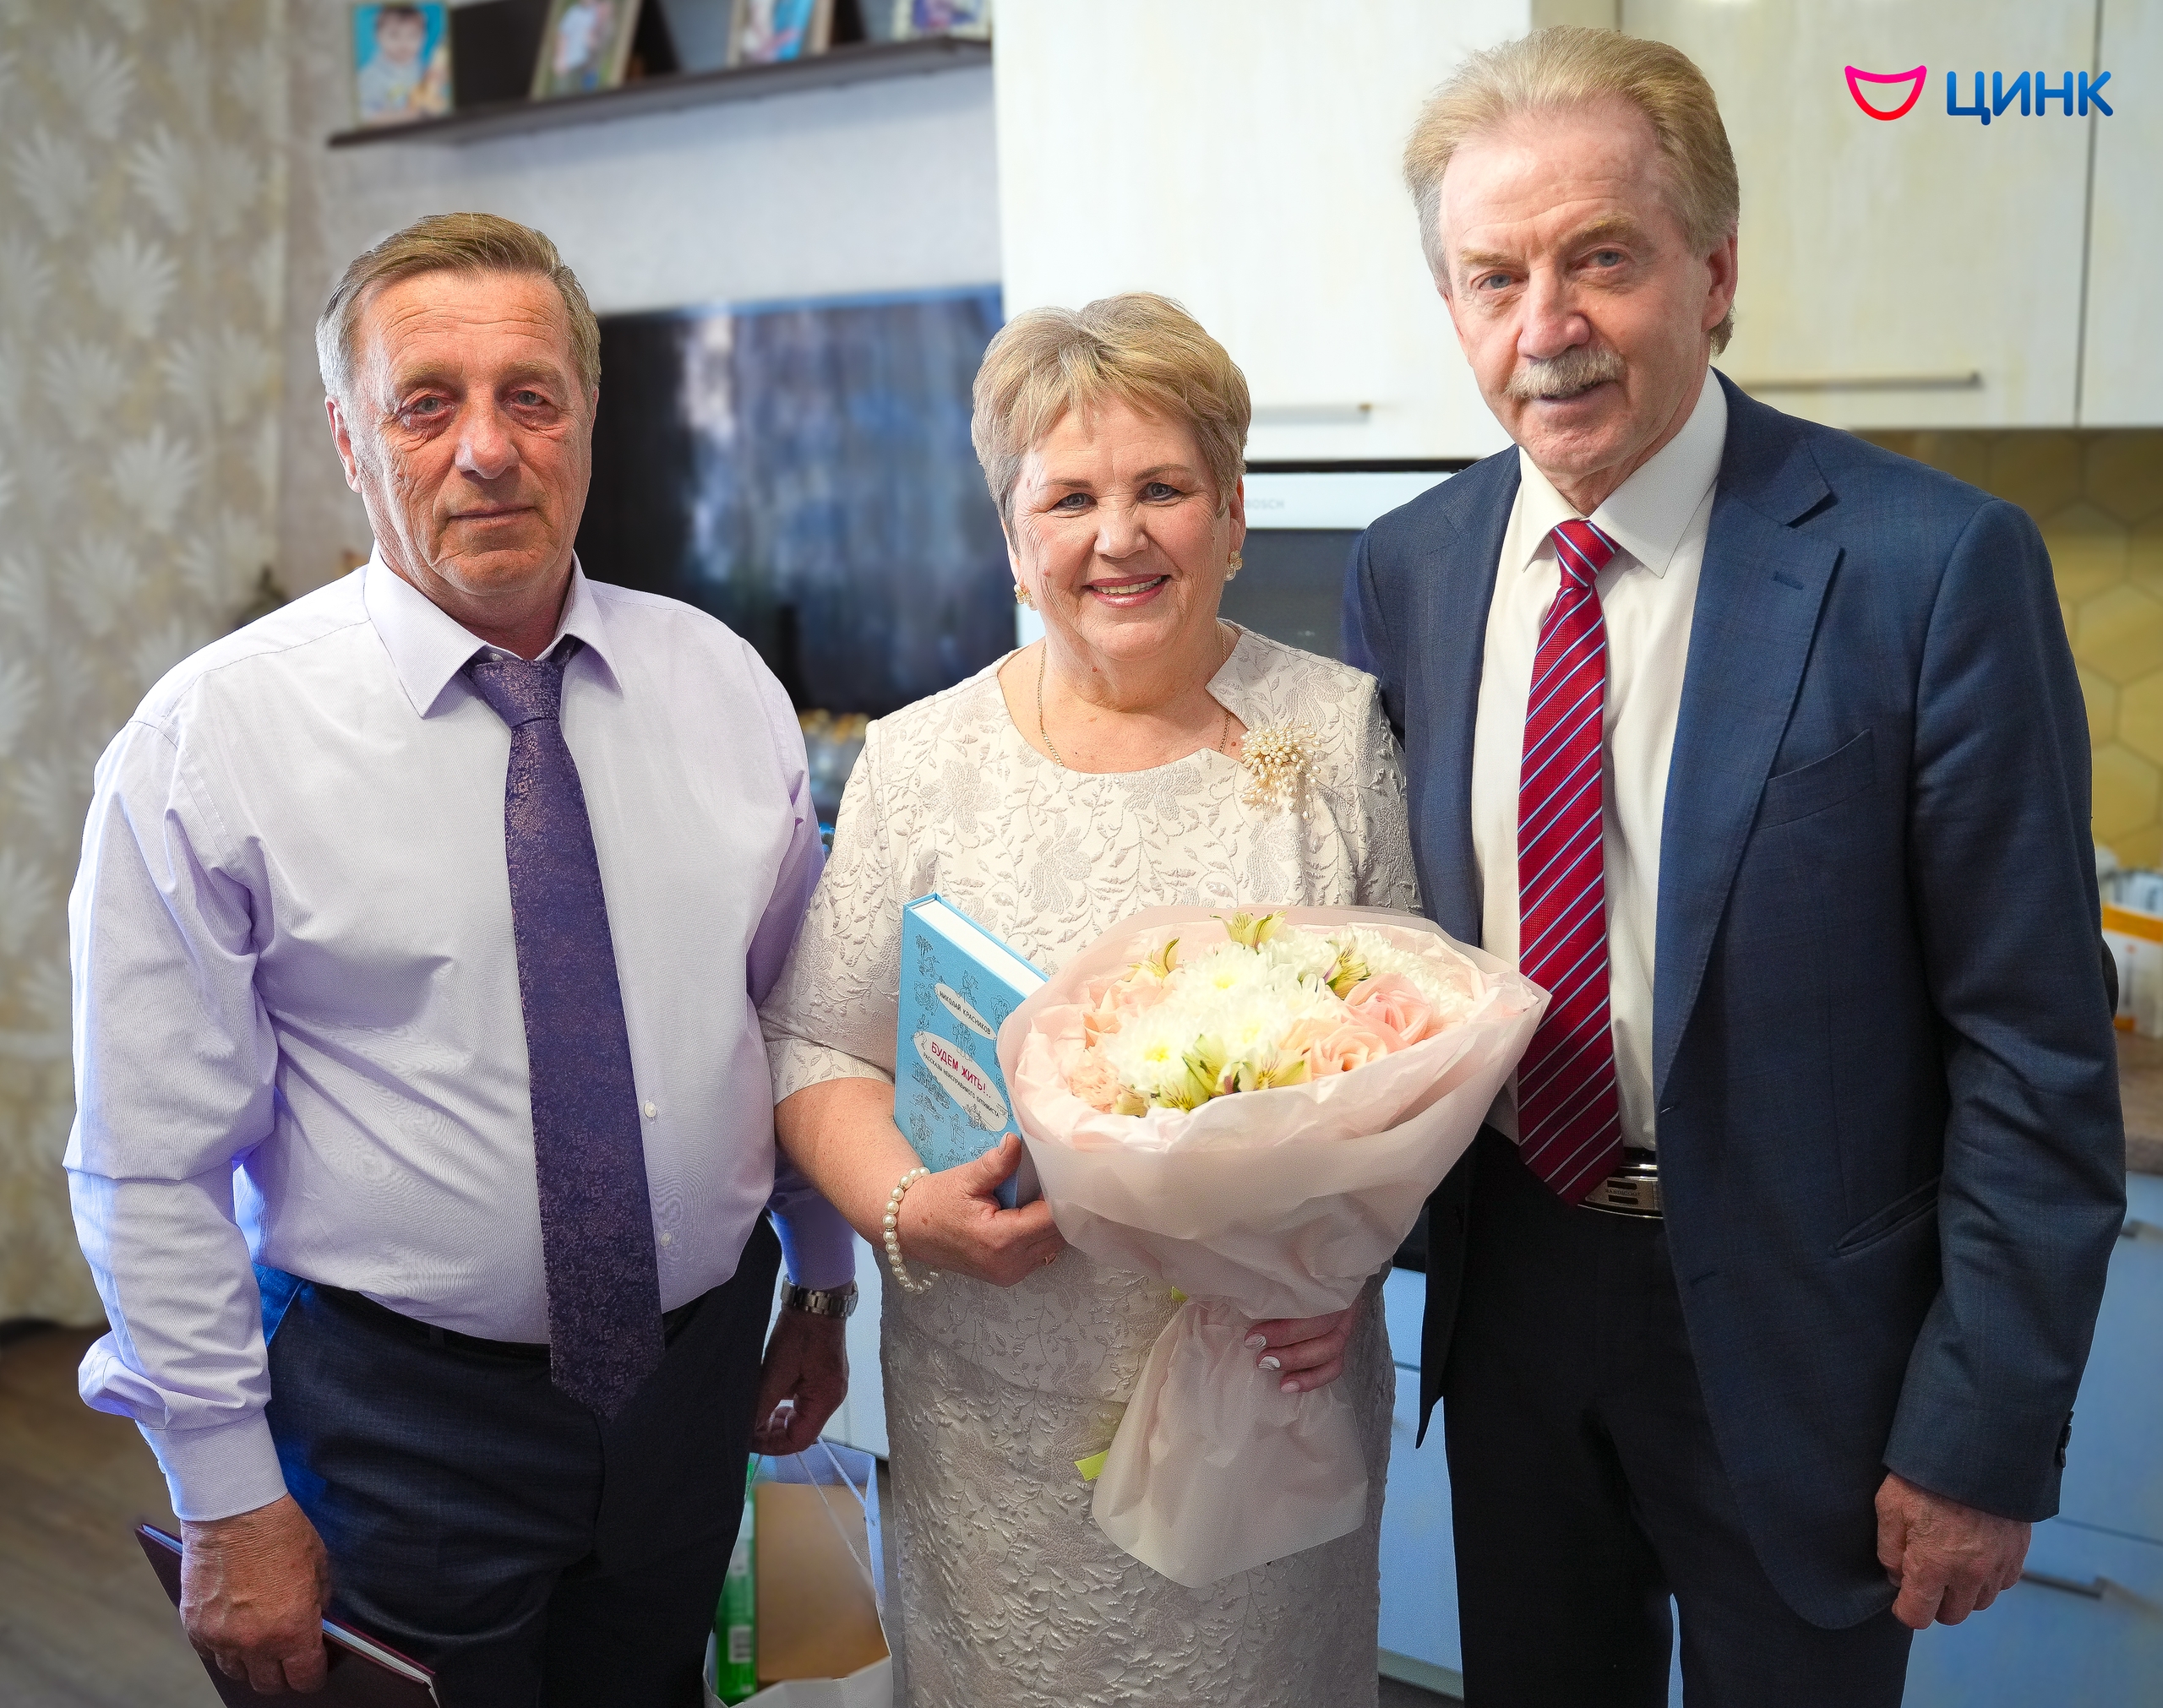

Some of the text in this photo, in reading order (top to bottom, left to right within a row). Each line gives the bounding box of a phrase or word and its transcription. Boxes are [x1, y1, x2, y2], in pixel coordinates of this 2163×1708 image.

[939, 990, 991, 1035] НИКОЛАЙ КРАСНИКОВ
[931, 1041, 959, 1071] БУДЕМ
[923, 1052, 1000, 1118] РАССКАЗЫ НЕИСПРАВИМОГО ОПТИМИСТА
